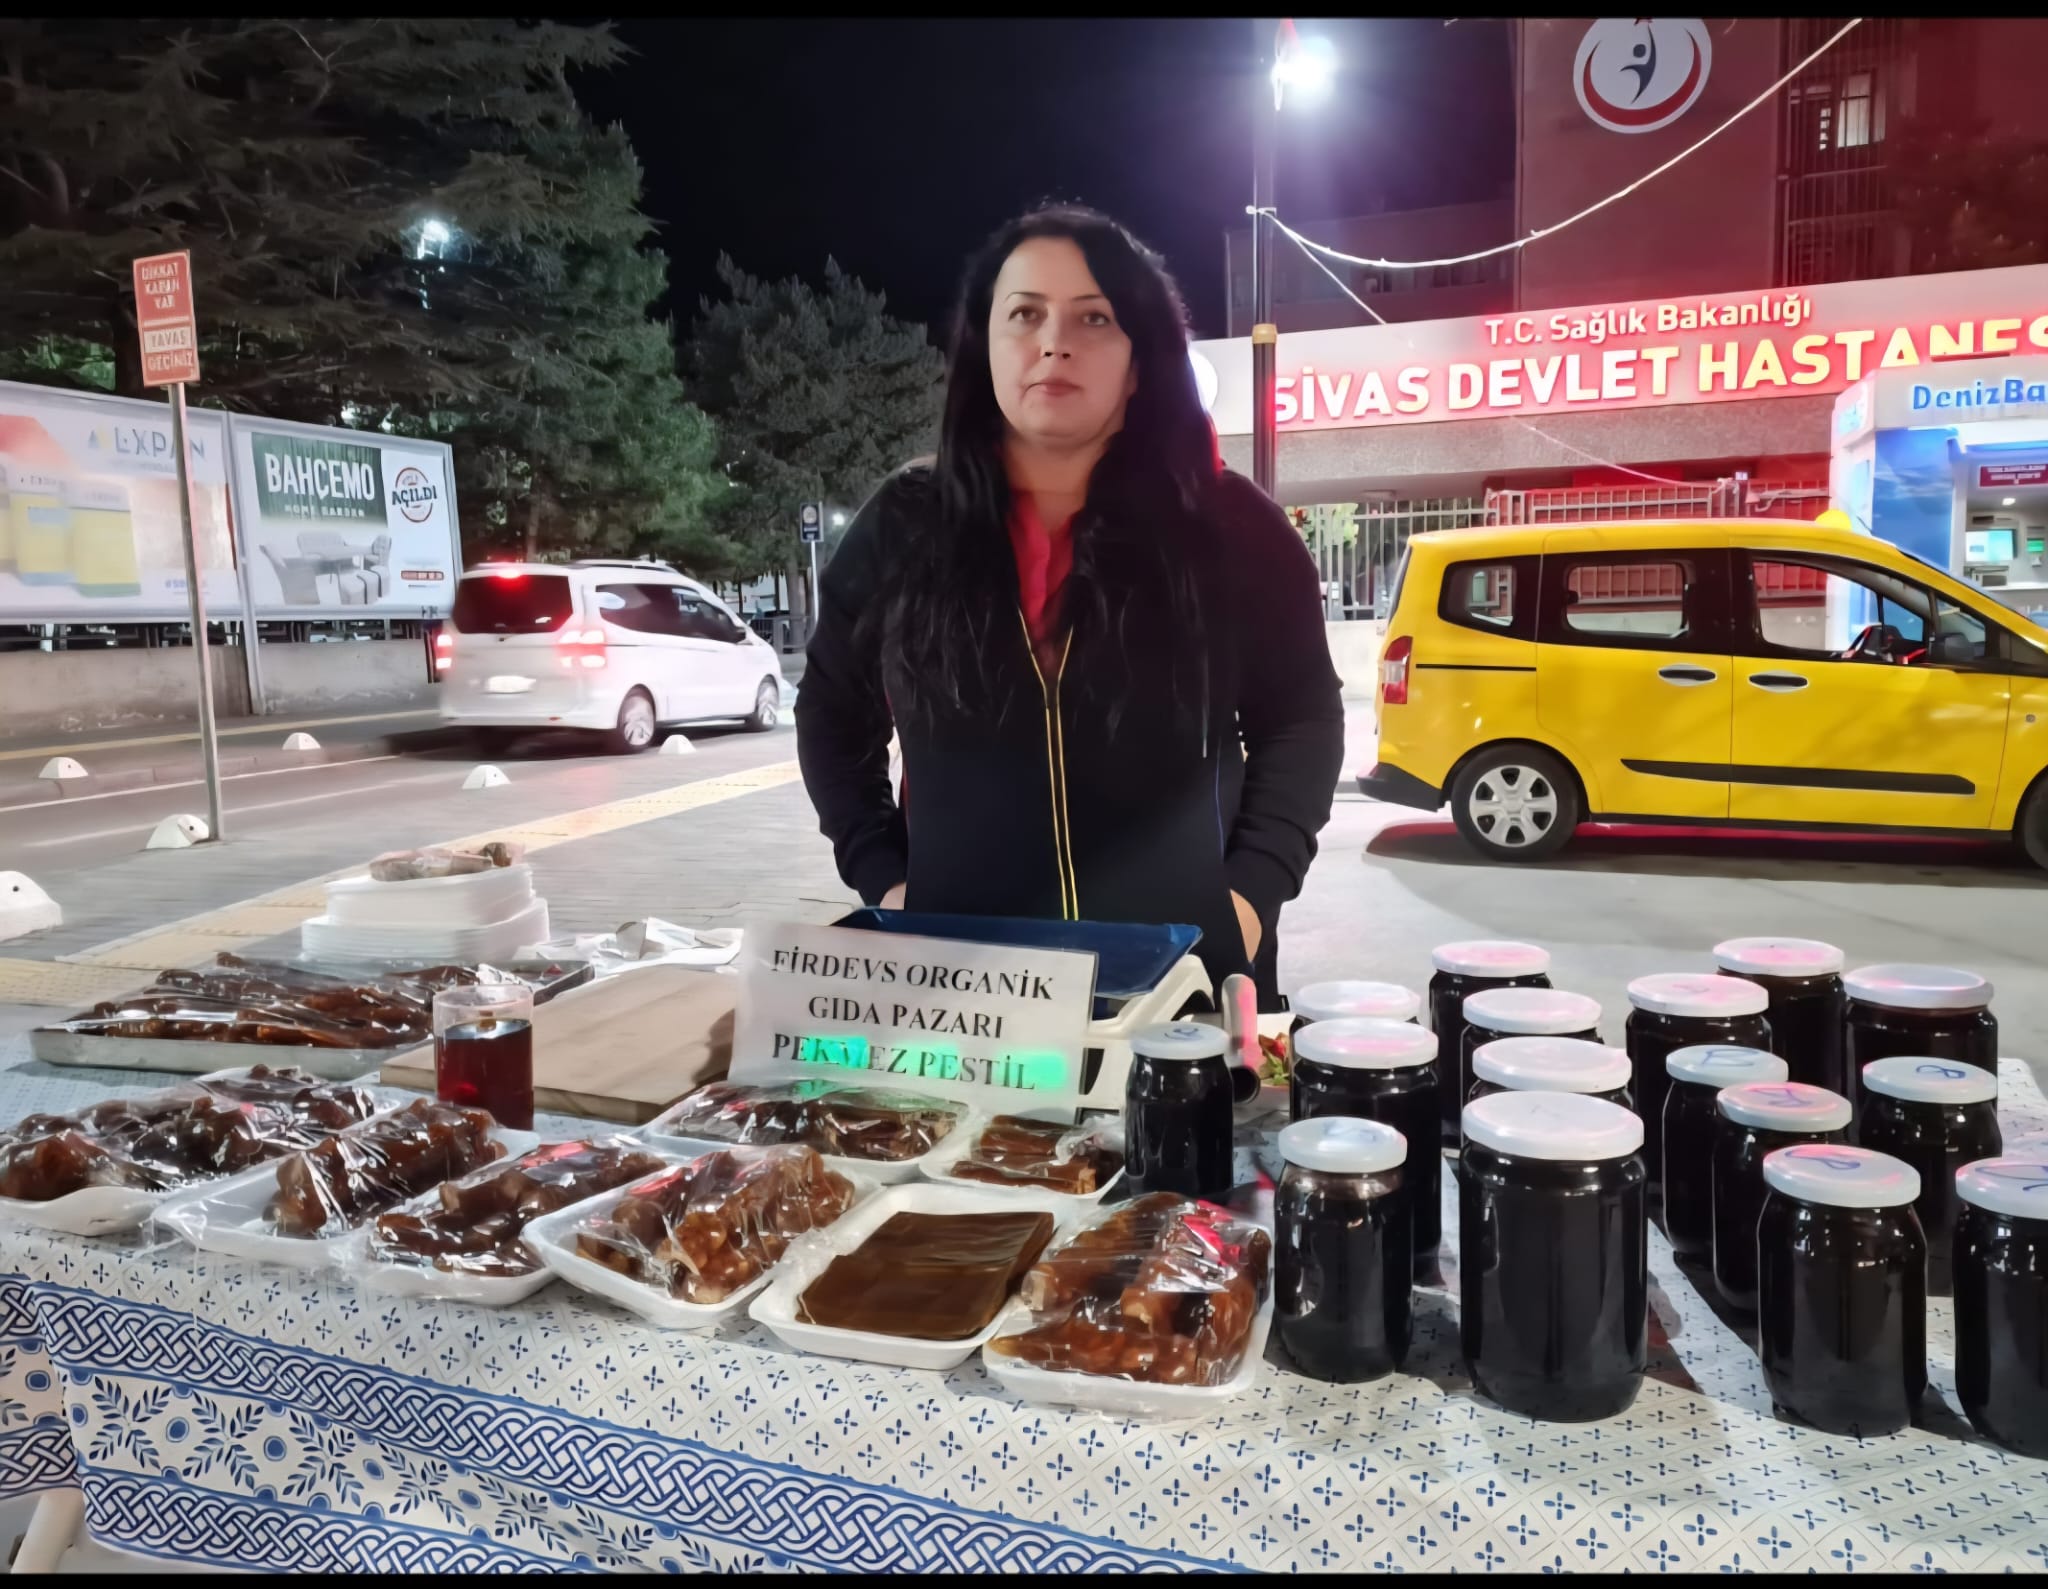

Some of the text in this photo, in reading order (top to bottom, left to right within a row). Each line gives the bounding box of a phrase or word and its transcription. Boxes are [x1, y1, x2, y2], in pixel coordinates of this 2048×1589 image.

[1485, 293, 1812, 345] T.C. Sağlık Bakanlığı
[1276, 366, 1431, 424] SİVAS
[1448, 346, 1680, 411] DEVLET
[1913, 379, 2046, 410] DenizBa
[264, 453, 376, 502] BAHÇEMO
[391, 485, 438, 508] AÇILDI
[772, 945, 1054, 1001] FİRDEVS ORGANİK
[808, 995, 1005, 1039] GIDA PAZARI
[917, 1050, 1035, 1090] PESTİL
